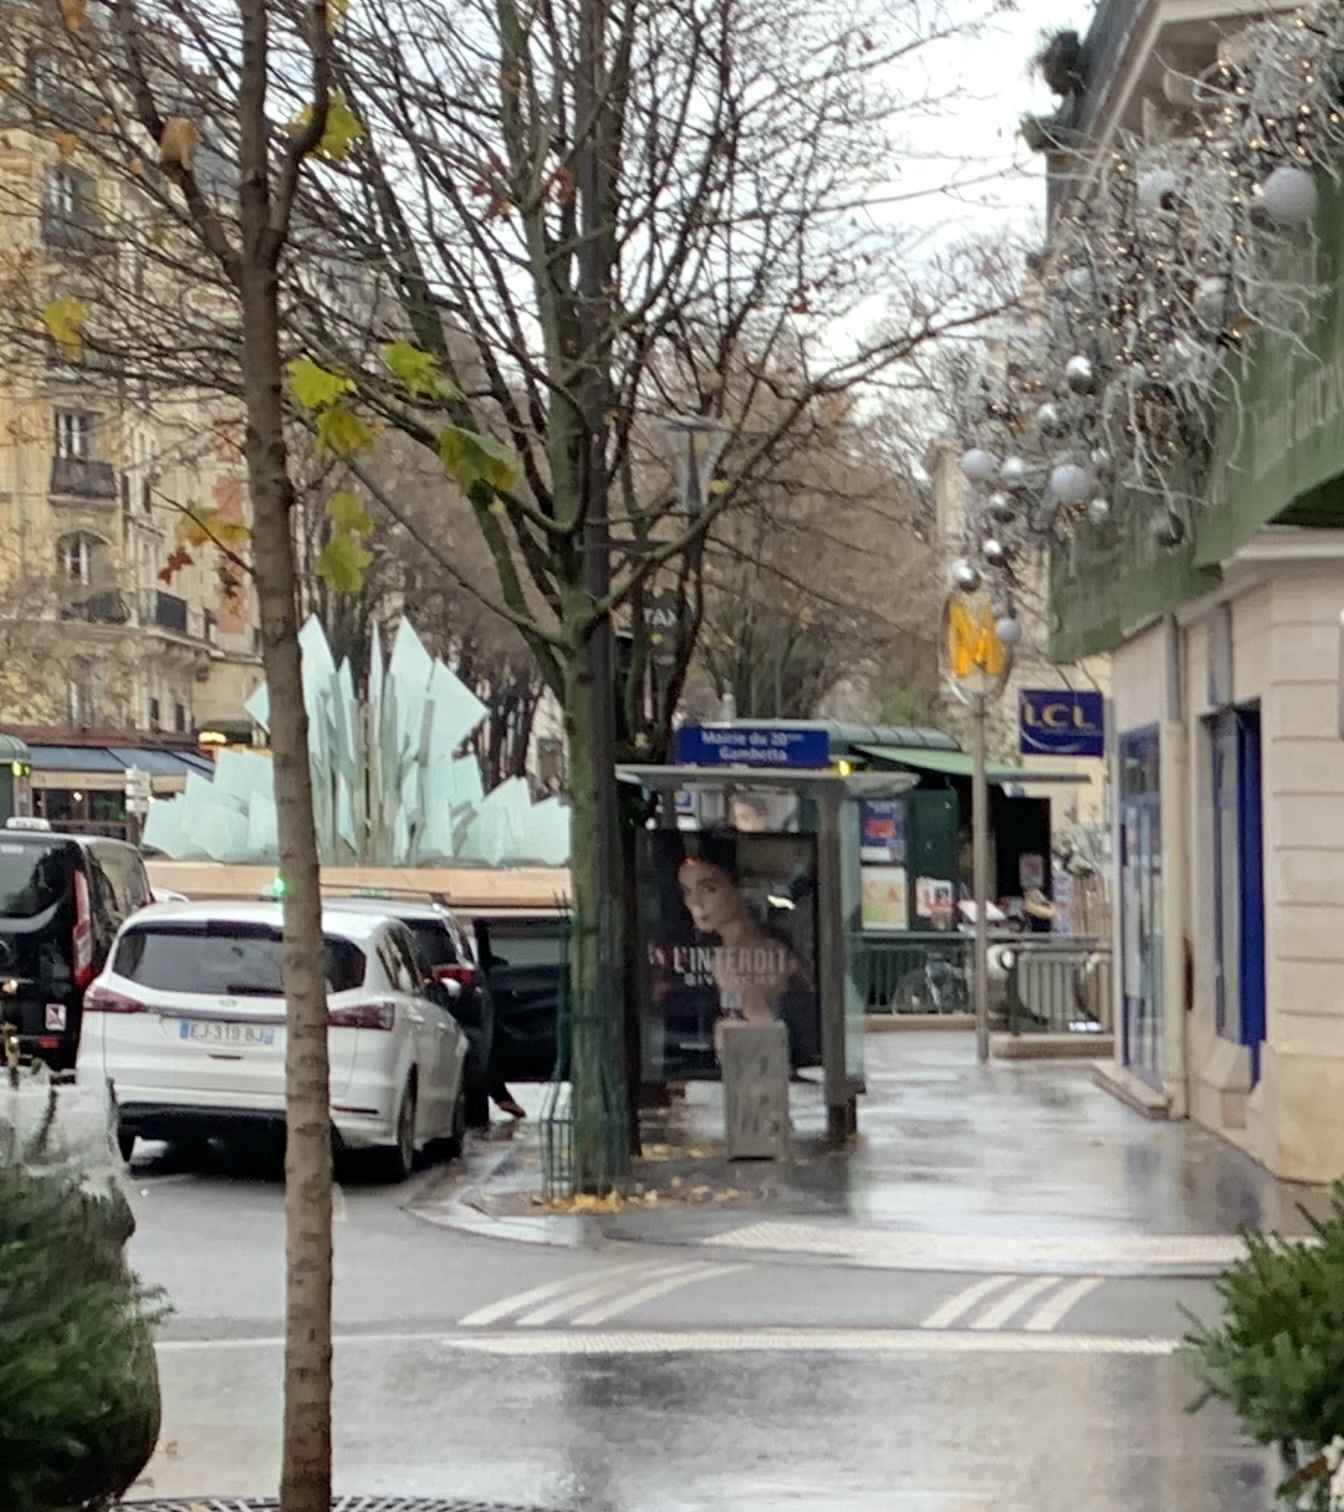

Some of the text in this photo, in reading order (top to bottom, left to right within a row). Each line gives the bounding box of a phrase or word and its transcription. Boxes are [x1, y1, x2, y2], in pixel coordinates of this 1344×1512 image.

[1023, 704, 1096, 729] LCL
[701, 731, 747, 745] Mairie
[748, 732, 768, 746] du
[718, 746, 788, 761] Gambetta
